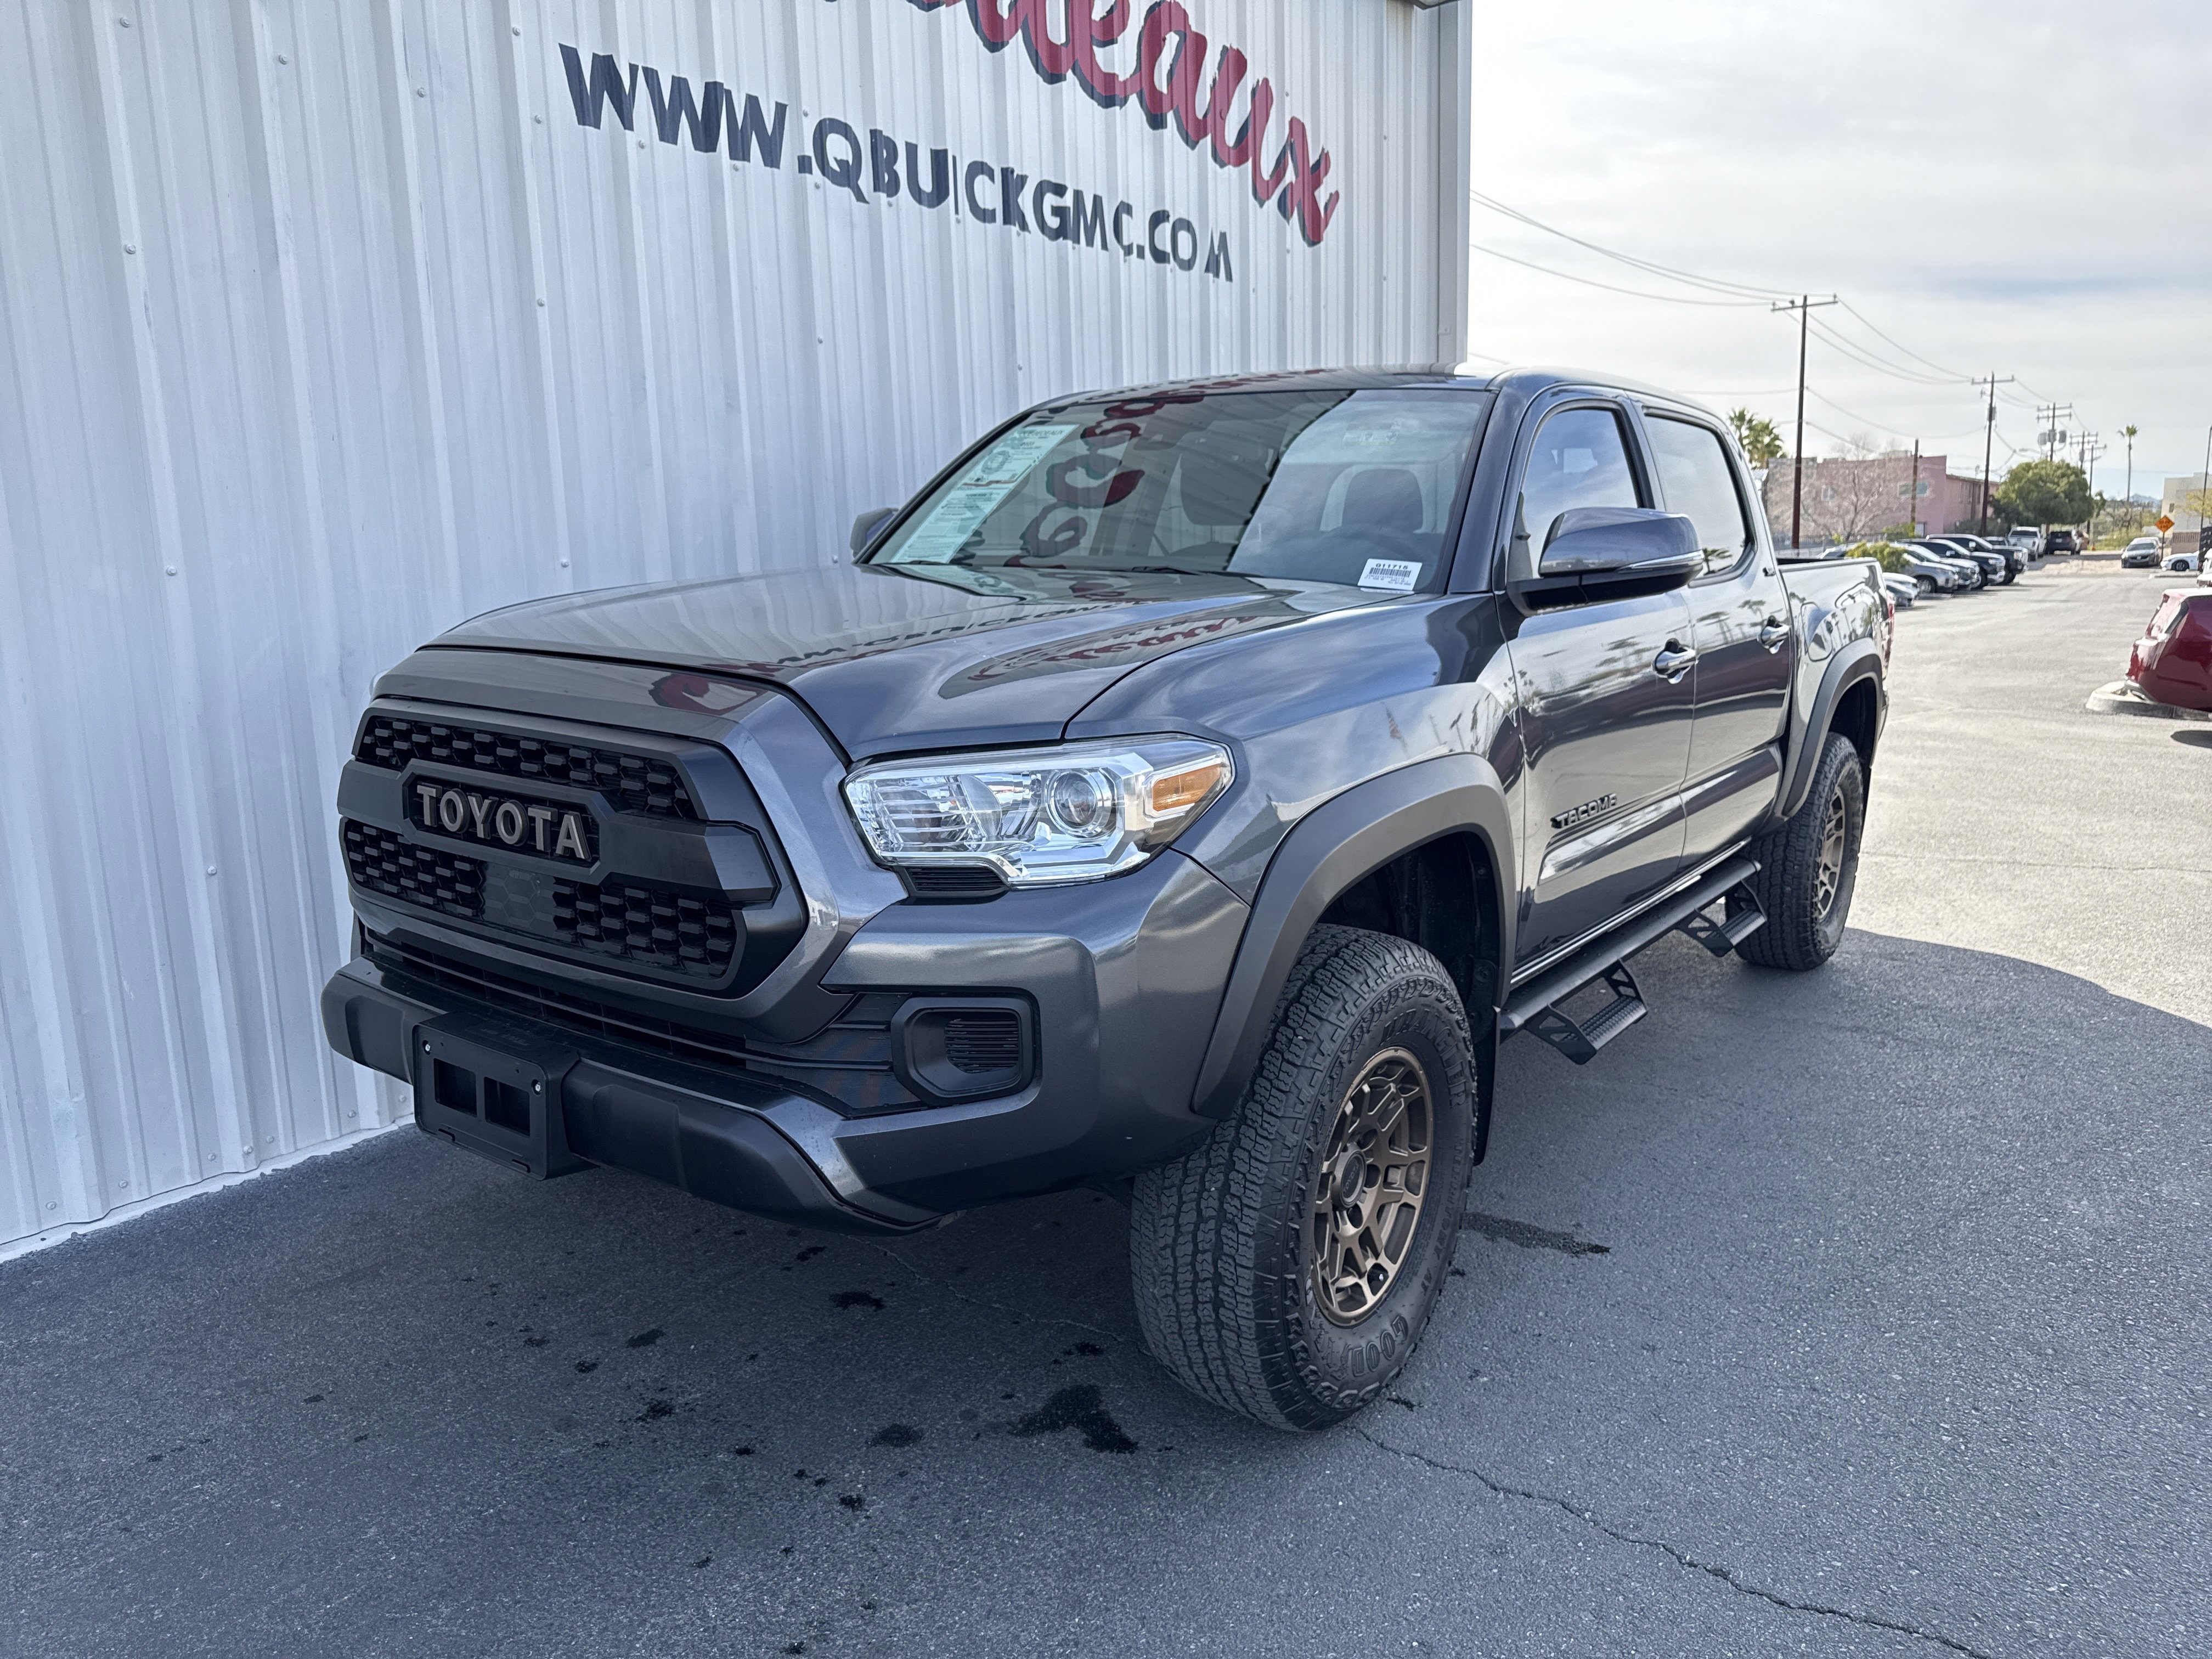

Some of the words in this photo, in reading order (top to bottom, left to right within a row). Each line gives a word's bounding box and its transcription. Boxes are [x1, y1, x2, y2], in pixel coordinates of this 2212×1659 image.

[558, 43, 1233, 282] WWW.QBUICKGMC.COM
[416, 784, 592, 861] TOYOTA
[1550, 793, 1617, 829] TACOMA
[1379, 1008, 1468, 1109] WRANGLER
